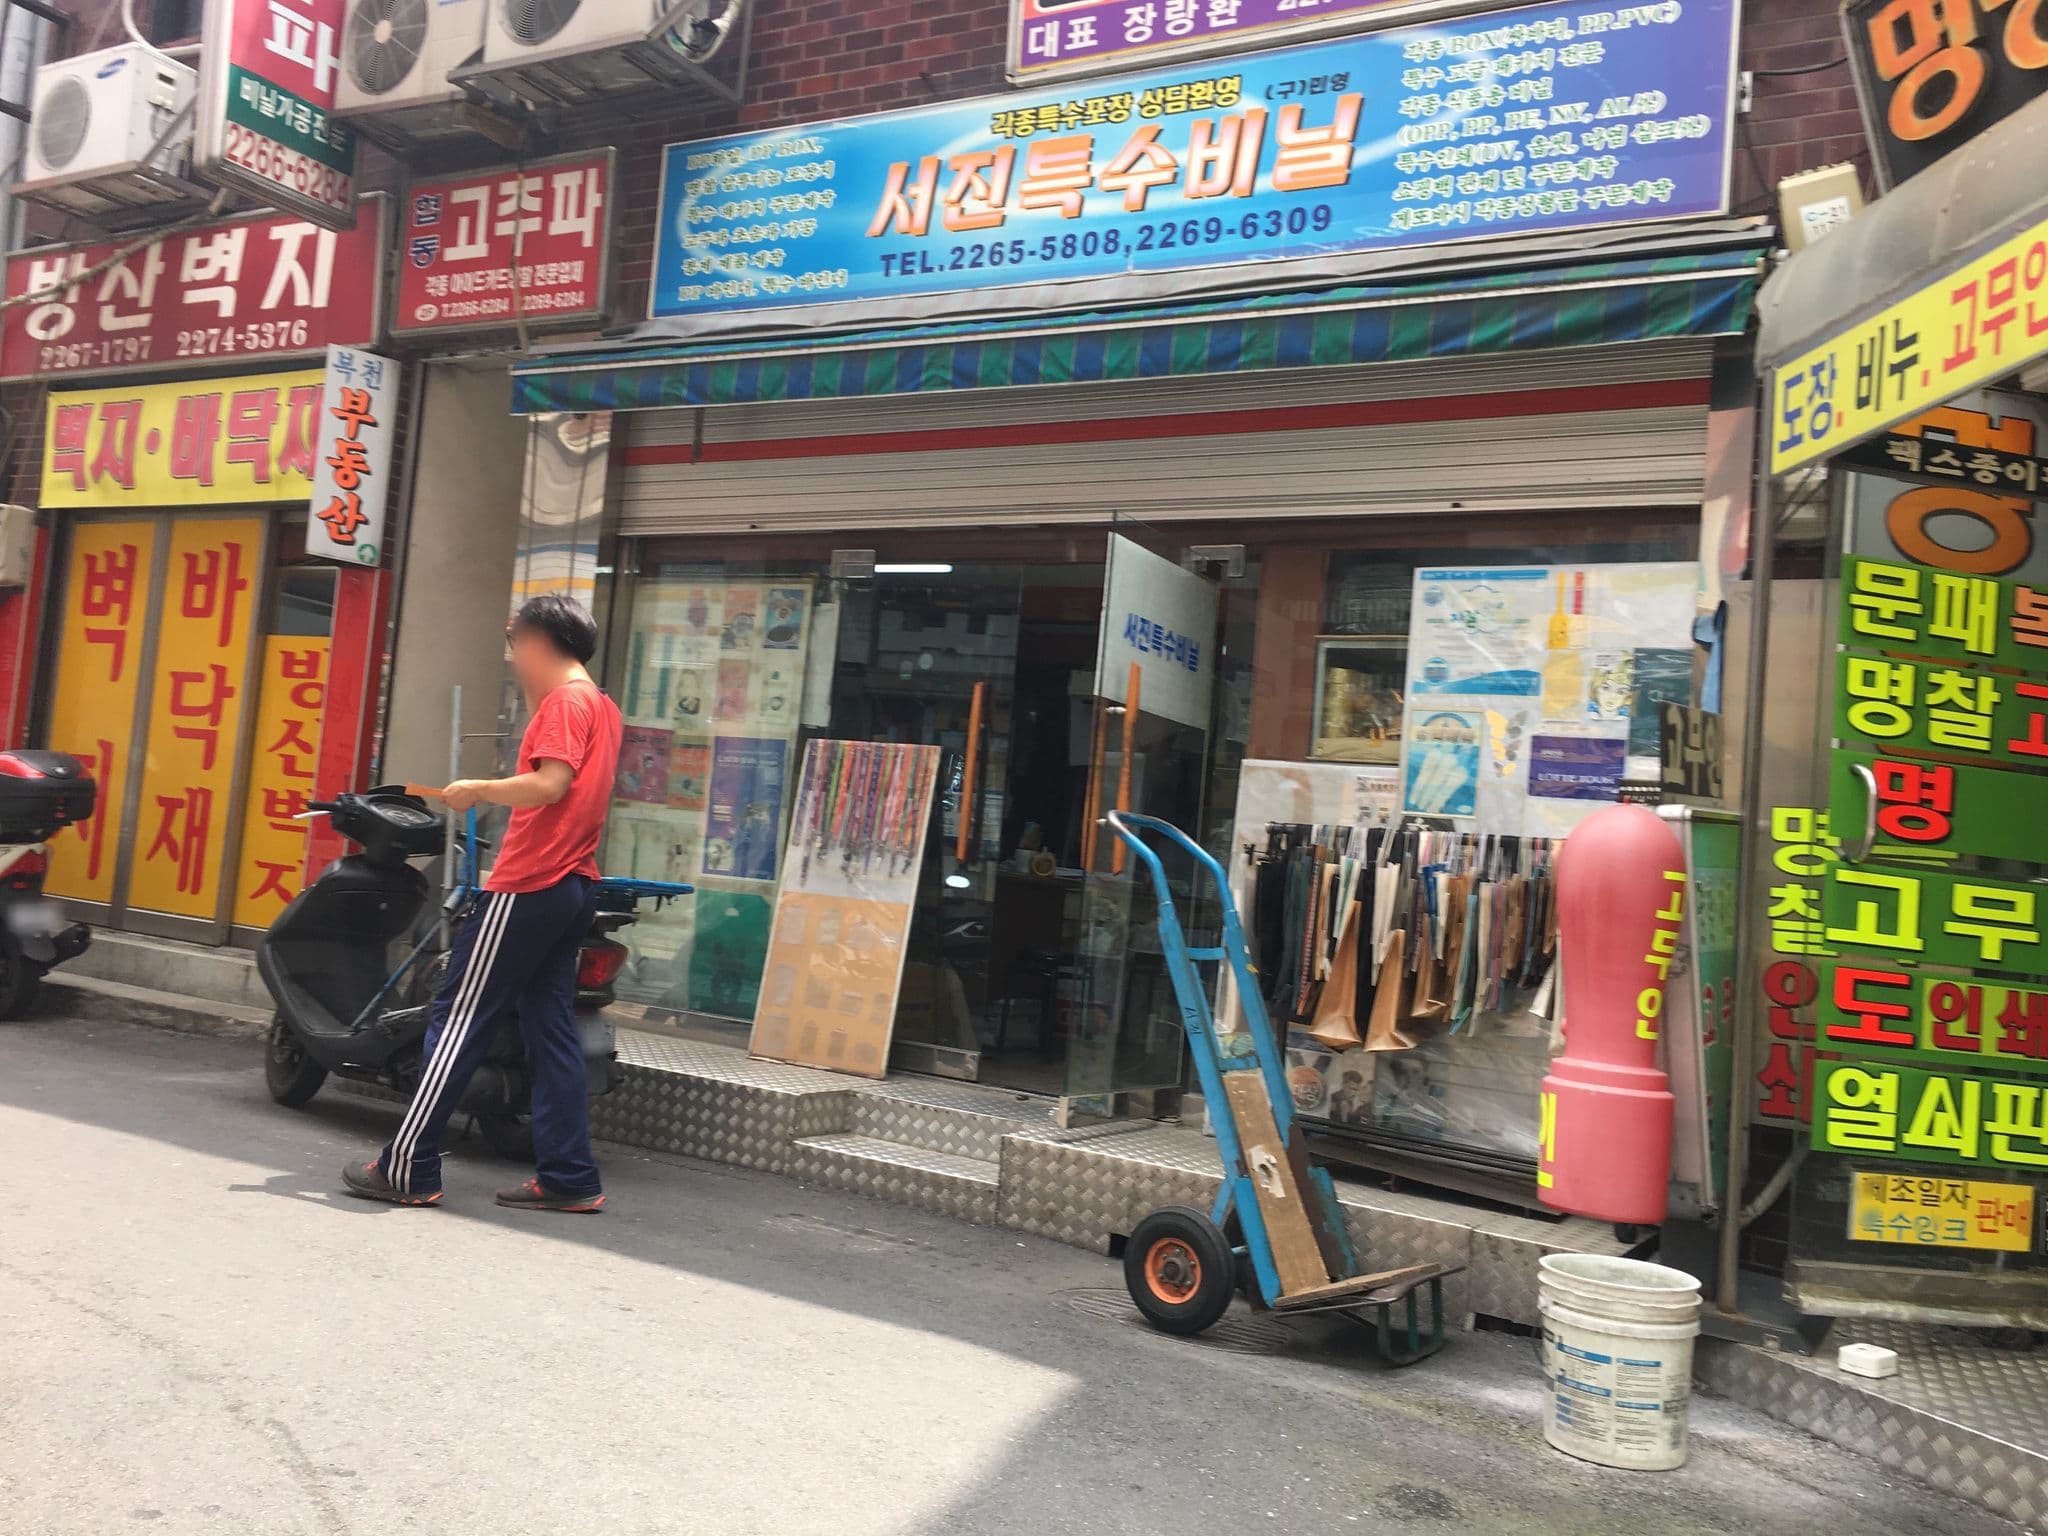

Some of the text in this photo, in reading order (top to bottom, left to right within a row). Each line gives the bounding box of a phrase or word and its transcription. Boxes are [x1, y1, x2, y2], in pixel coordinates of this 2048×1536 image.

[1027, 15, 1098, 58] 대표
[1401, 67, 1445, 90] 특수
[1445, 59, 1489, 82] 고급
[1557, 41, 1606, 67] 전문
[990, 94, 1133, 138] 각종특수포장
[1137, 76, 1242, 118] 상담환영
[865, 93, 1363, 237] 서진특수비닐
[443, 168, 602, 261] 고주파
[881, 204, 1333, 276] TEL.2265-5808,2269-6309
[41, 319, 308, 369] 2267-1797 2274-5376
[316, 386, 379, 546] 부동산
[1849, 561, 1999, 655] 문패
[146, 541, 248, 895] 바닥재
[1846, 657, 2001, 753] 명찰
[1825, 869, 2040, 962] 고무
[1975, 1197, 2029, 1237] 판매
